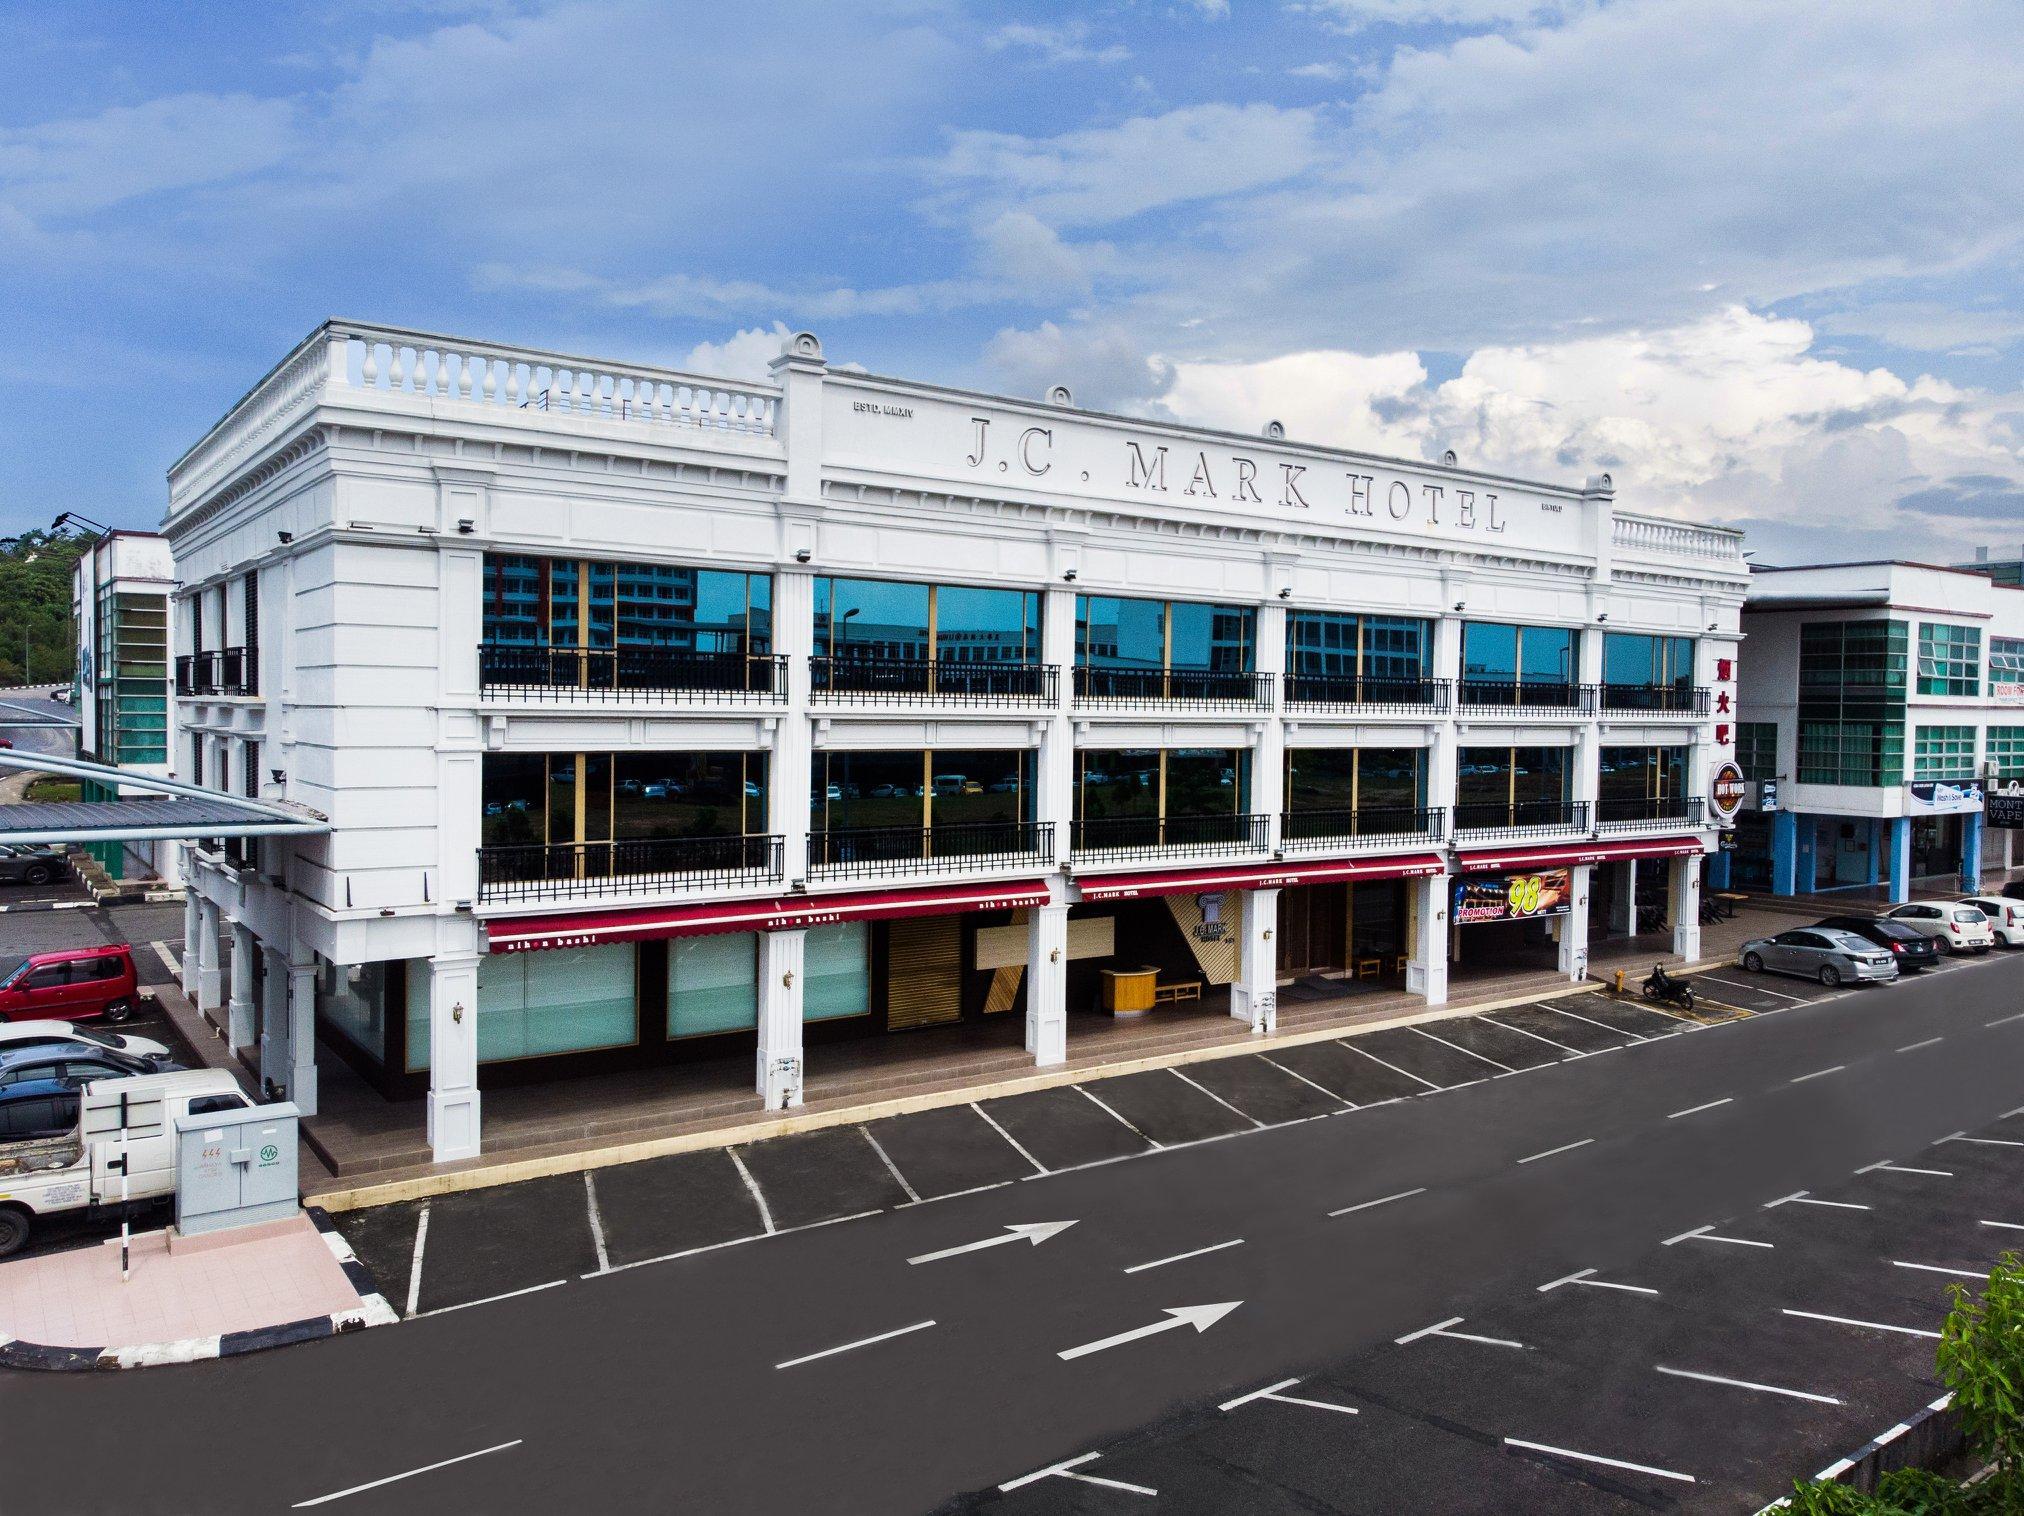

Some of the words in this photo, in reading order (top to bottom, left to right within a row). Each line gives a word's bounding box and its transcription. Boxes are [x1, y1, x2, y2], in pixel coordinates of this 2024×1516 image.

[883, 405, 914, 418] MMXIV
[1125, 441, 1310, 508] MARK
[1345, 473, 1506, 533] HOTEL
[1989, 799, 2023, 810] MONT
[1989, 810, 2023, 821] VAPE
[1509, 875, 1542, 917] 98
[1458, 905, 1505, 917] PROMOTION
[808, 913, 840, 923] bashi
[557, 934, 597, 946] bashi
